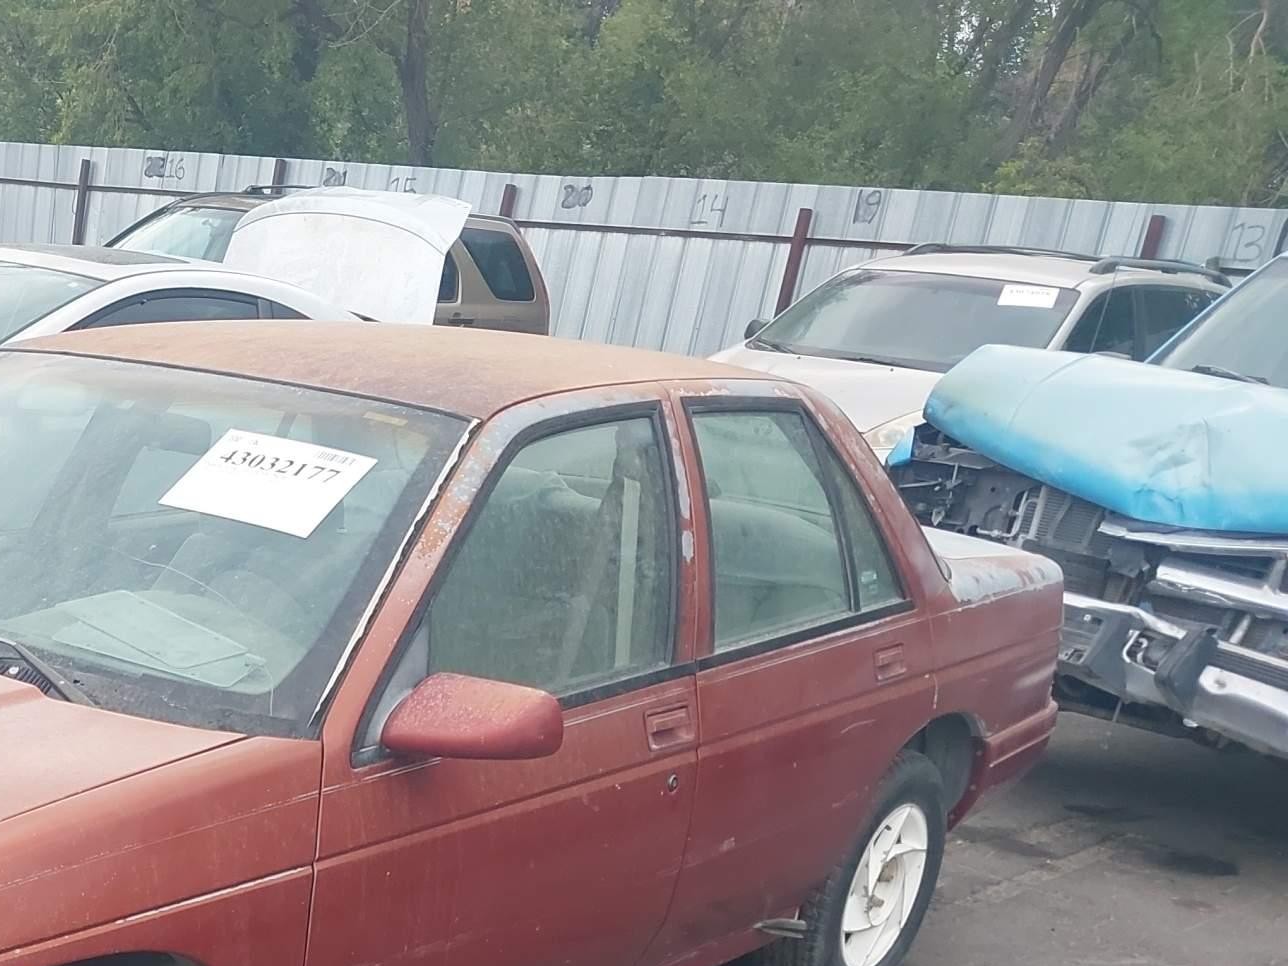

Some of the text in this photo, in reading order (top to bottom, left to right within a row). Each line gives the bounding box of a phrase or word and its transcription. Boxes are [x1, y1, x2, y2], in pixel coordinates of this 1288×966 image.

[165, 158, 185, 180] 16
[690, 194, 728, 227] 14
[1231, 222, 1265, 263] 13
[219, 450, 342, 483] 43032177
